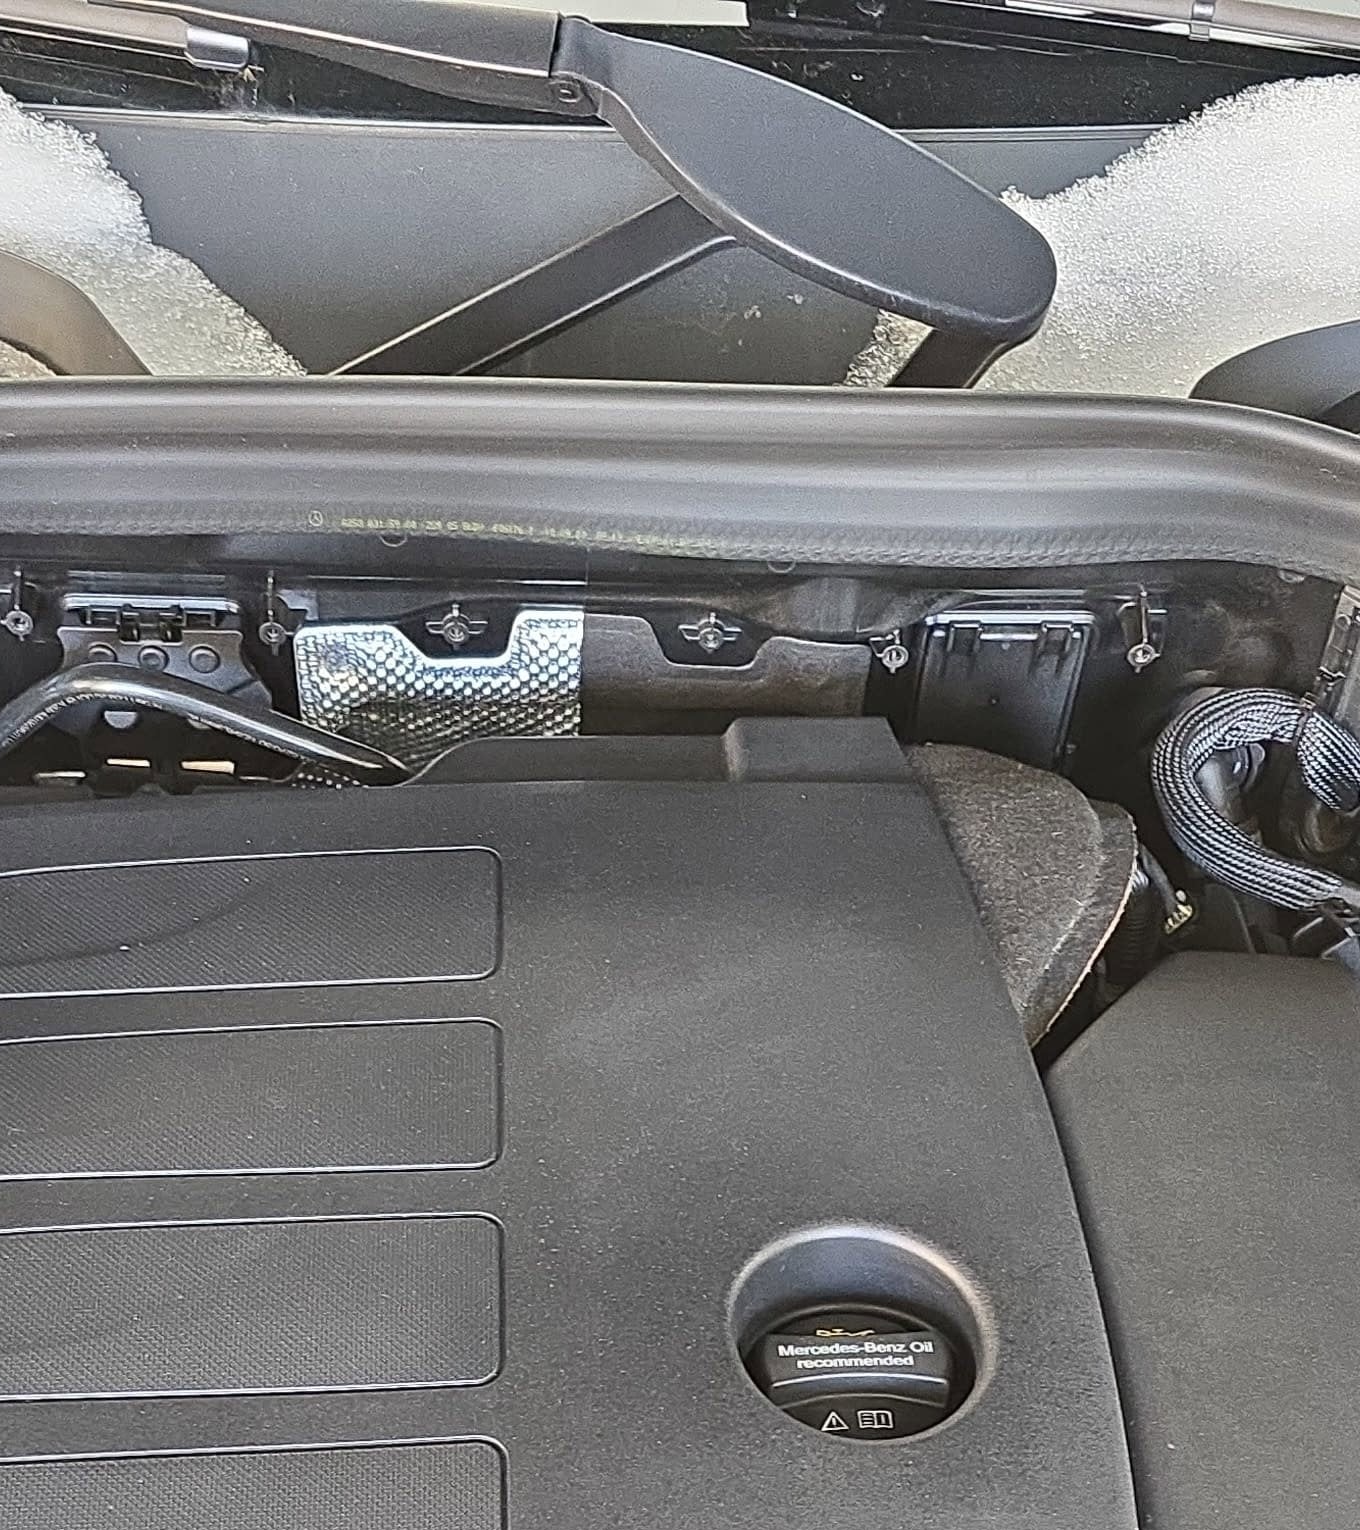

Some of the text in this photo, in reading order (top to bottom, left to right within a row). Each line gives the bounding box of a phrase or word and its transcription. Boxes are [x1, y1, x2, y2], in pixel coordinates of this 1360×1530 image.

[777, 1342, 934, 1357] Mercedes-Benz Oil
[796, 1355, 914, 1369] recommended
